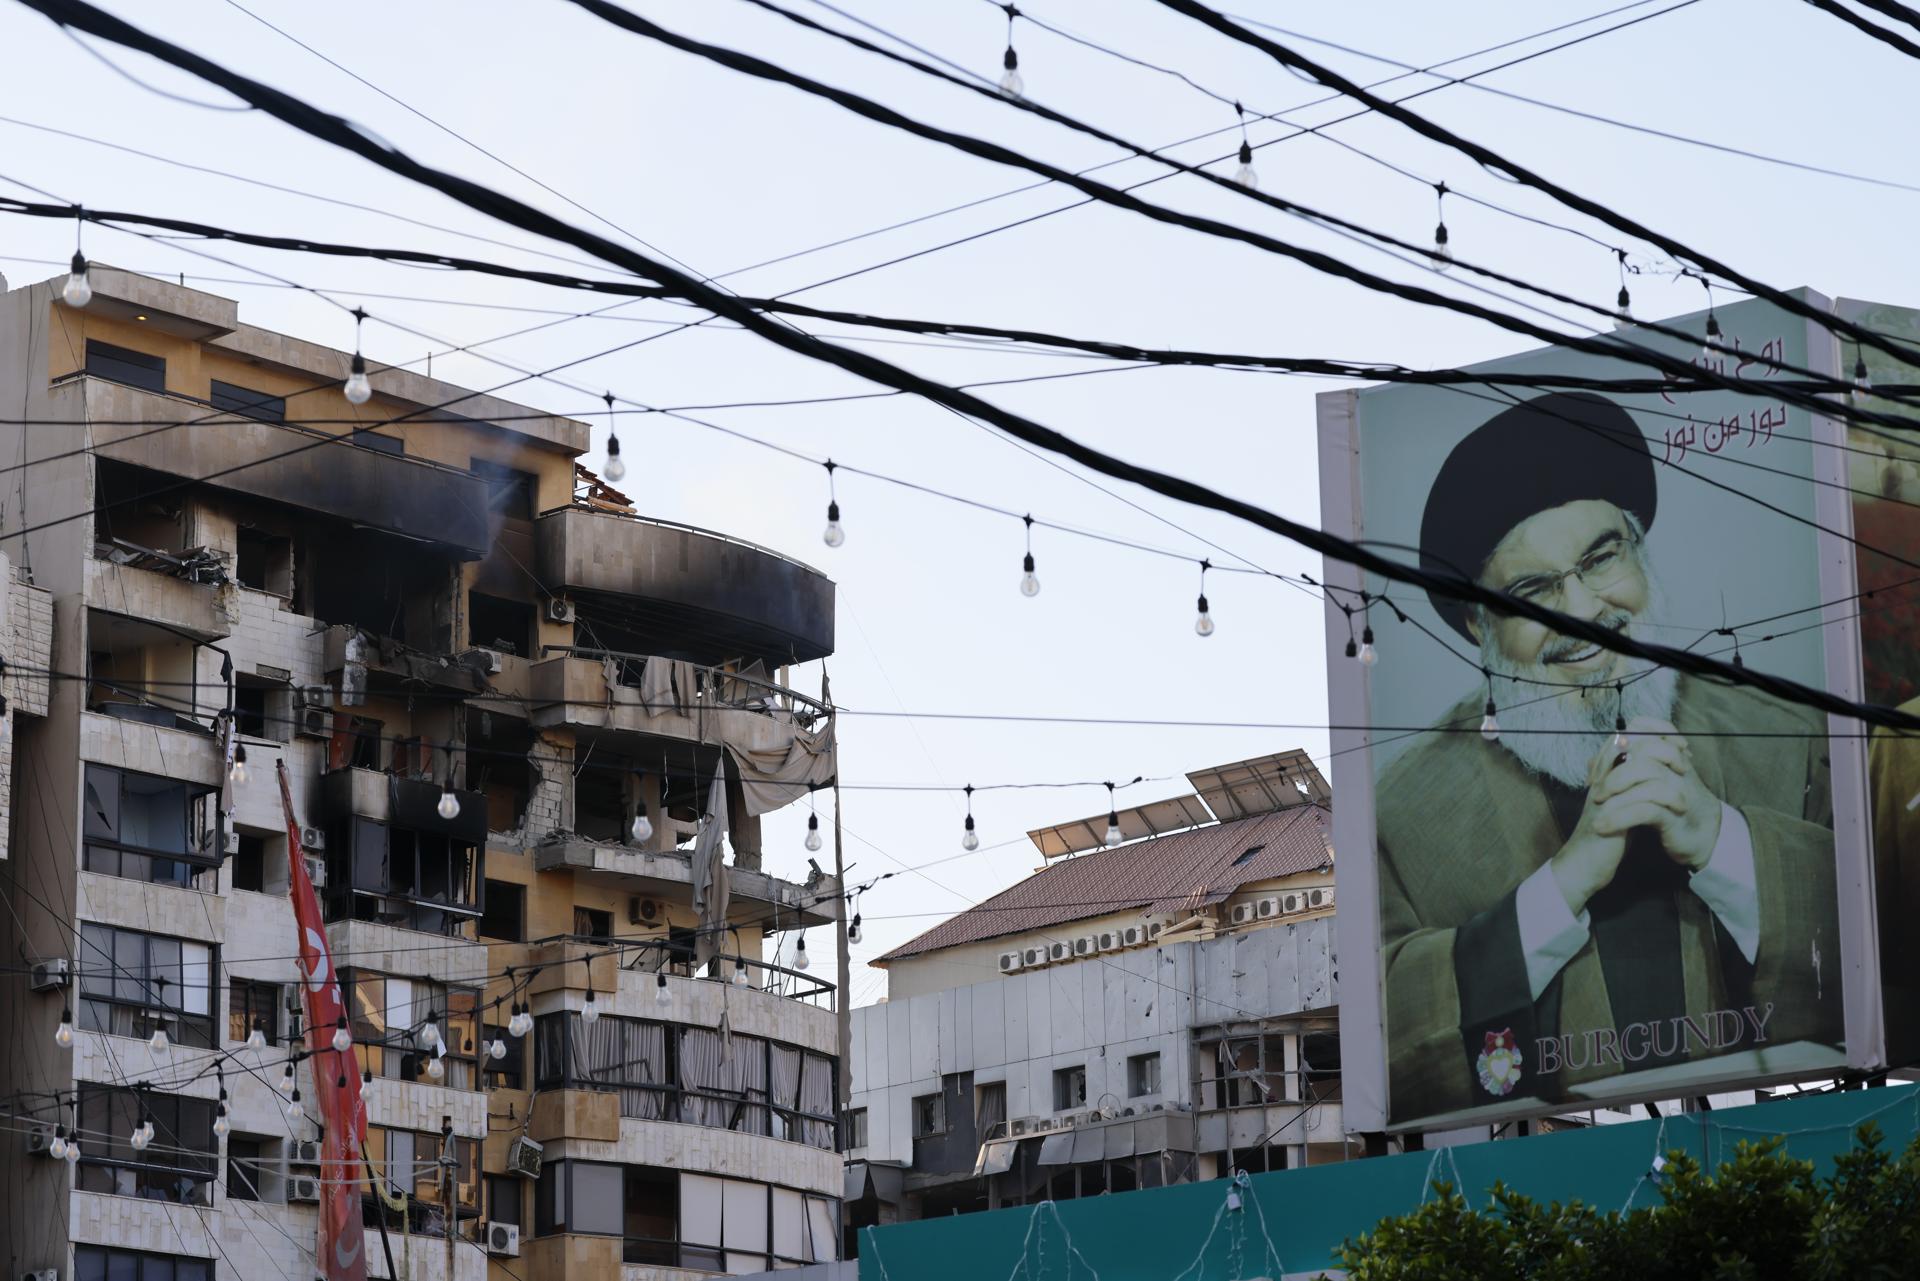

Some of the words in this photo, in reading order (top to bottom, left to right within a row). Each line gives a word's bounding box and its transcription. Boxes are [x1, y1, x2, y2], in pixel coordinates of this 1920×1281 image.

[1661, 413, 1696, 467] نور
[1703, 412, 1740, 453] من
[1535, 1002, 1775, 1075] BURGUNDY
